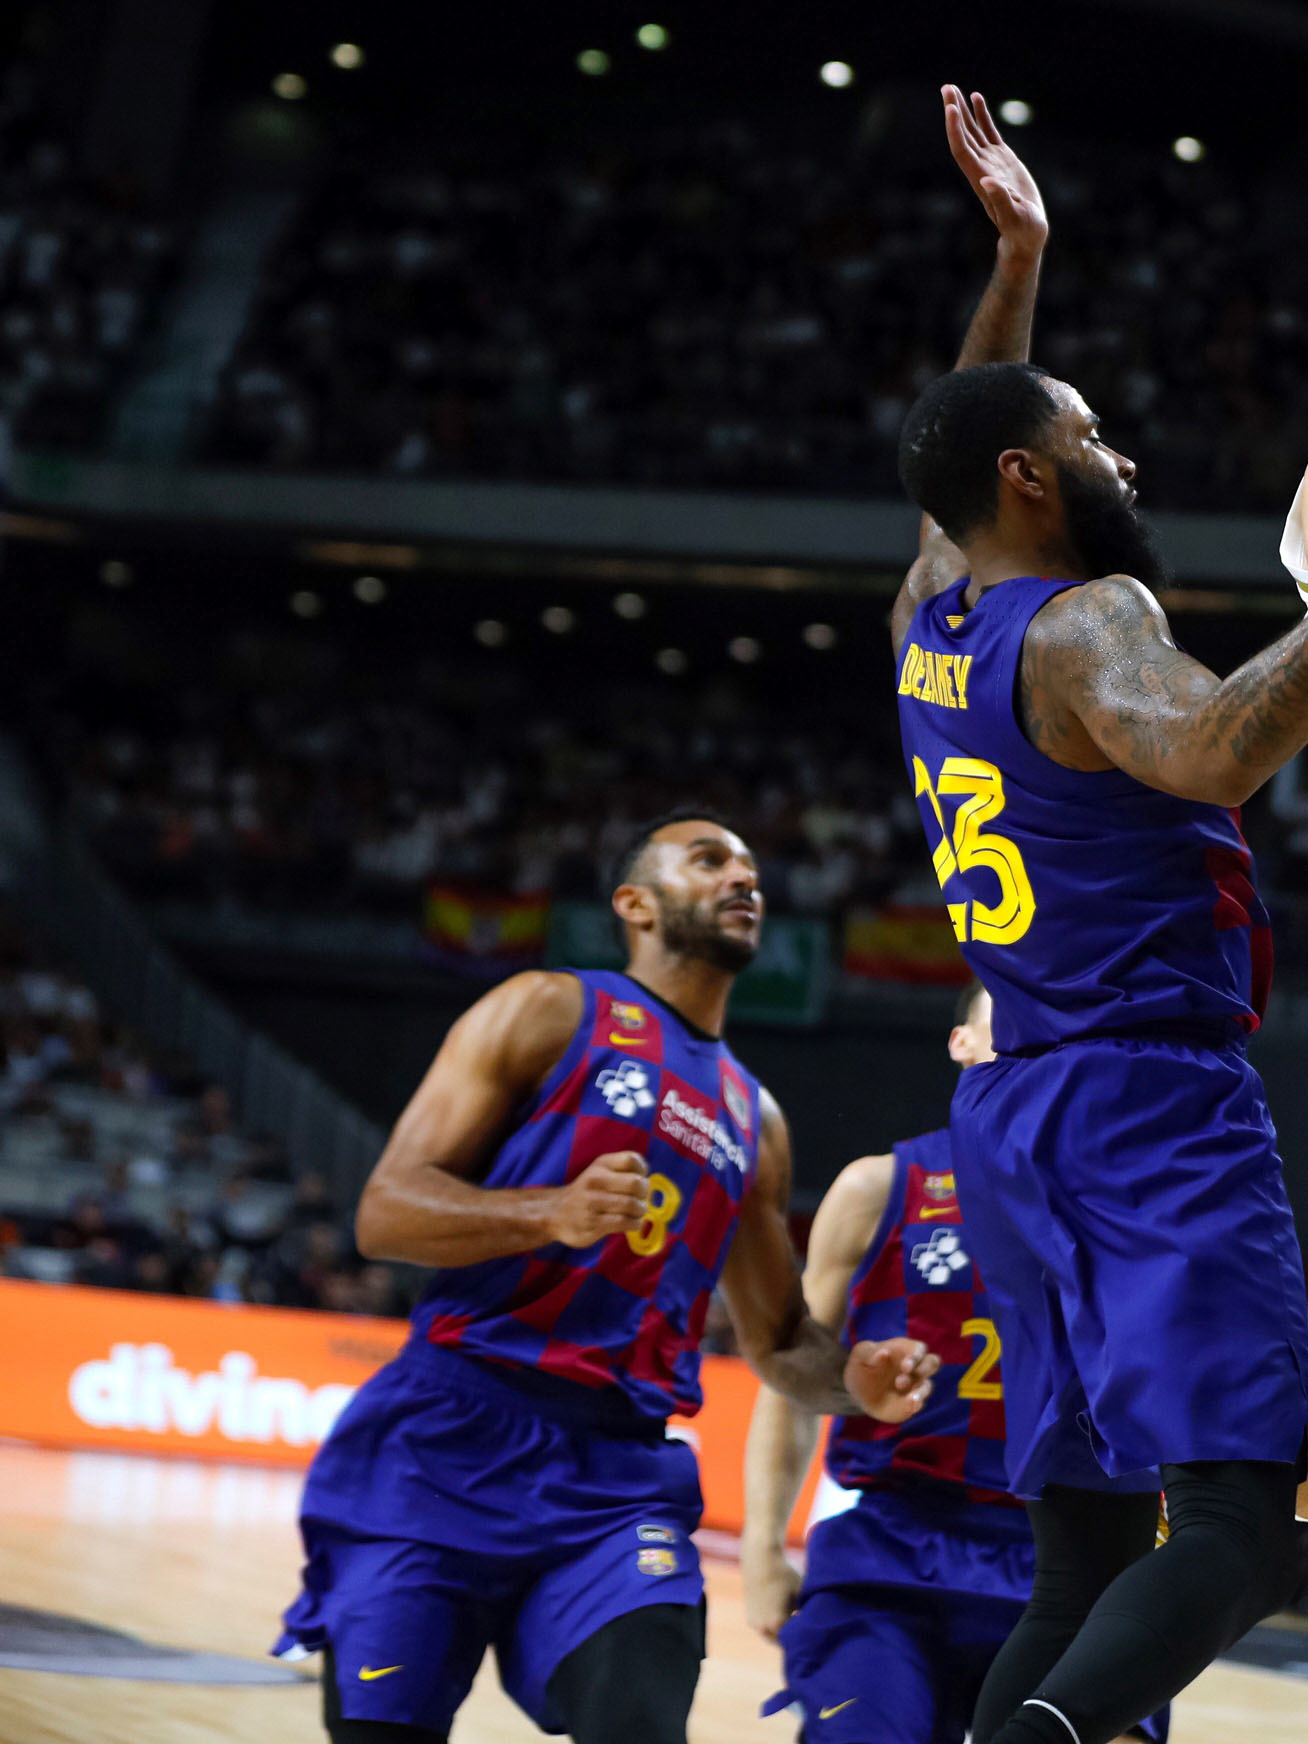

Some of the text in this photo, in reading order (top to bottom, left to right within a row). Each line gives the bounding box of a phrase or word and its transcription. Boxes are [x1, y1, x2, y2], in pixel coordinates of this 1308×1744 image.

[897, 642, 973, 709] DELANEY
[912, 754, 1037, 946] 23
[626, 1172, 682, 1257] 8
[957, 1318, 1003, 1400] 2
